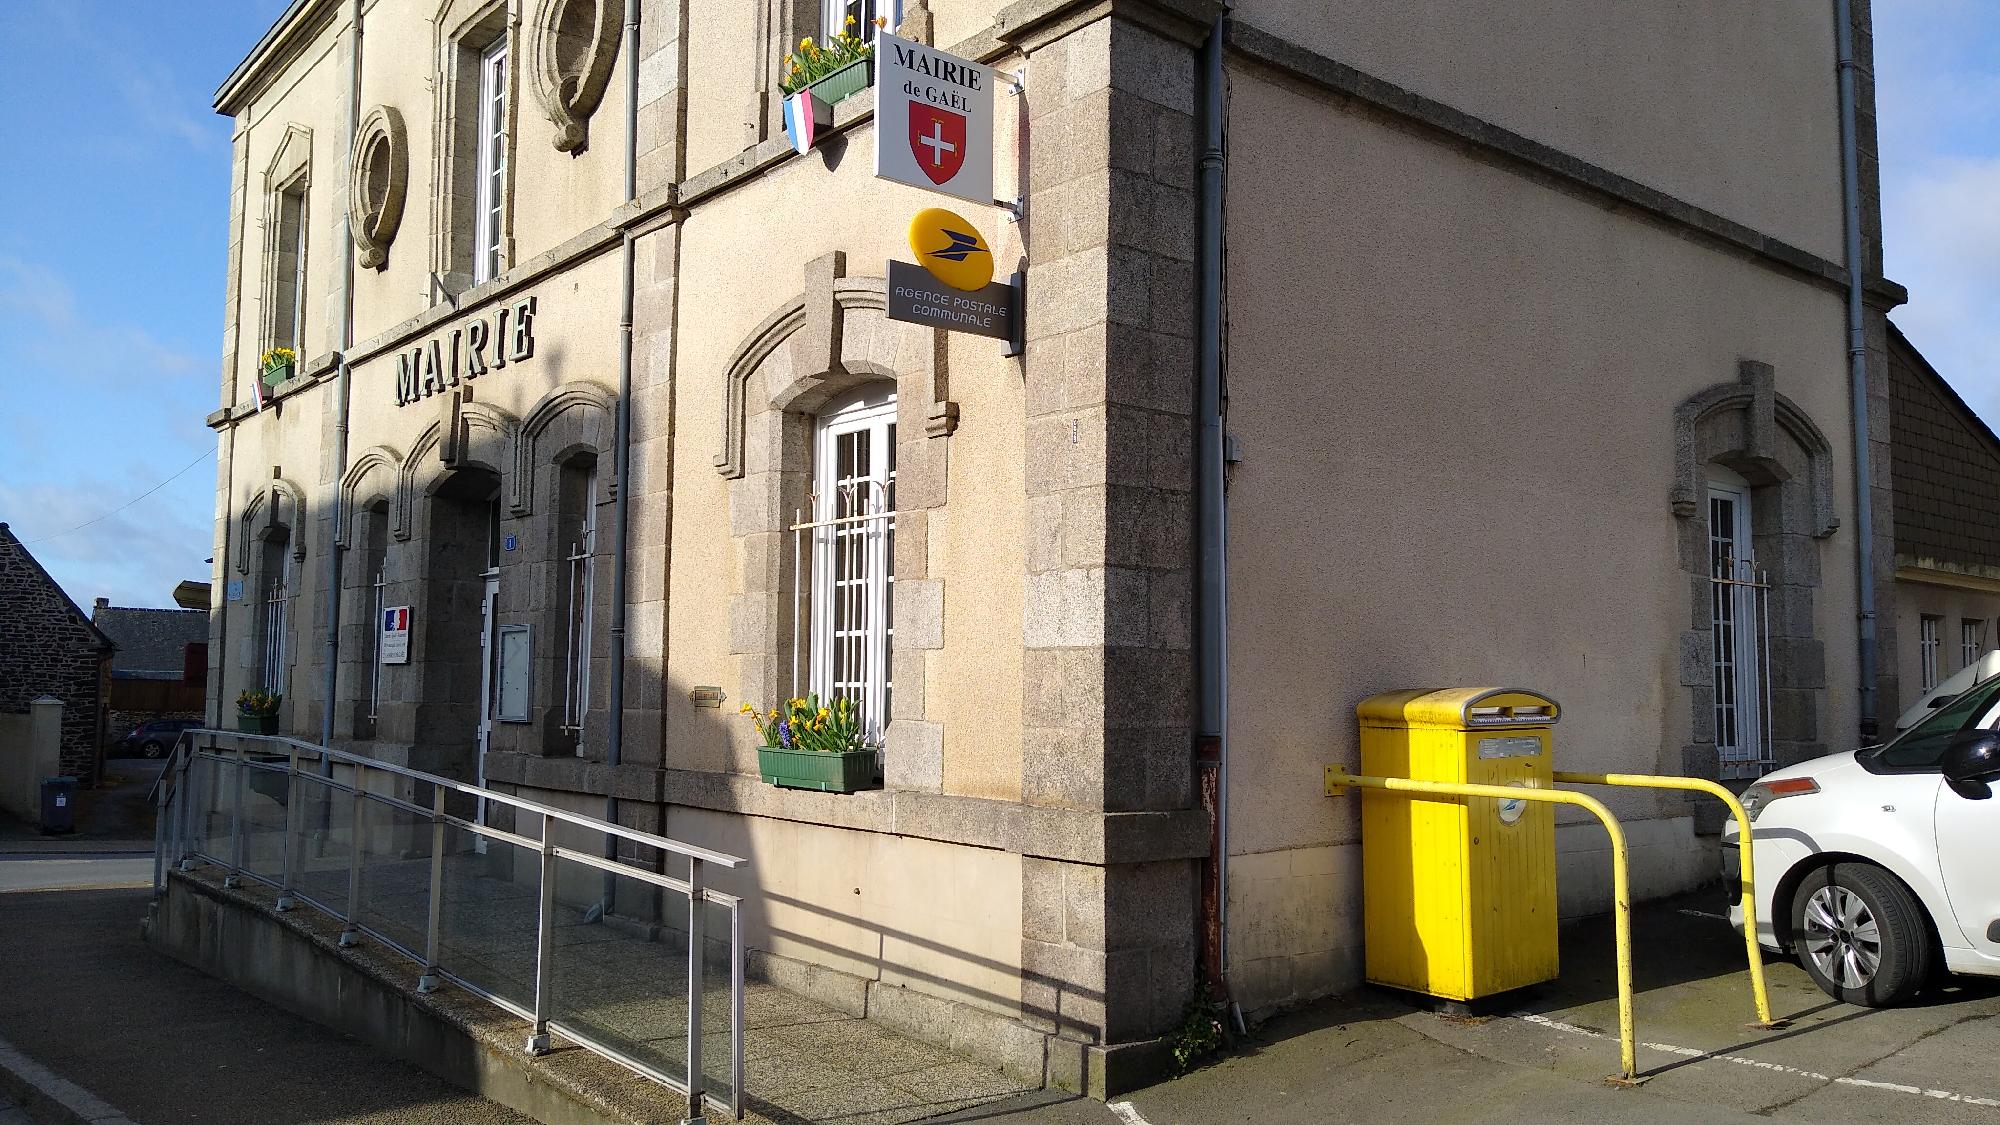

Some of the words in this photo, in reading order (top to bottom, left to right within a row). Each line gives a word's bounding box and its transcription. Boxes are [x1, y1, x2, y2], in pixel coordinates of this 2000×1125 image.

[893, 43, 982, 92] MAIRIE
[903, 79, 921, 98] de
[925, 86, 972, 113] GAËL
[895, 286, 950, 306] AGENCE
[953, 297, 1007, 317] POSTALE
[912, 304, 992, 328] COMMUNALE
[394, 296, 538, 408] MAIRIE
